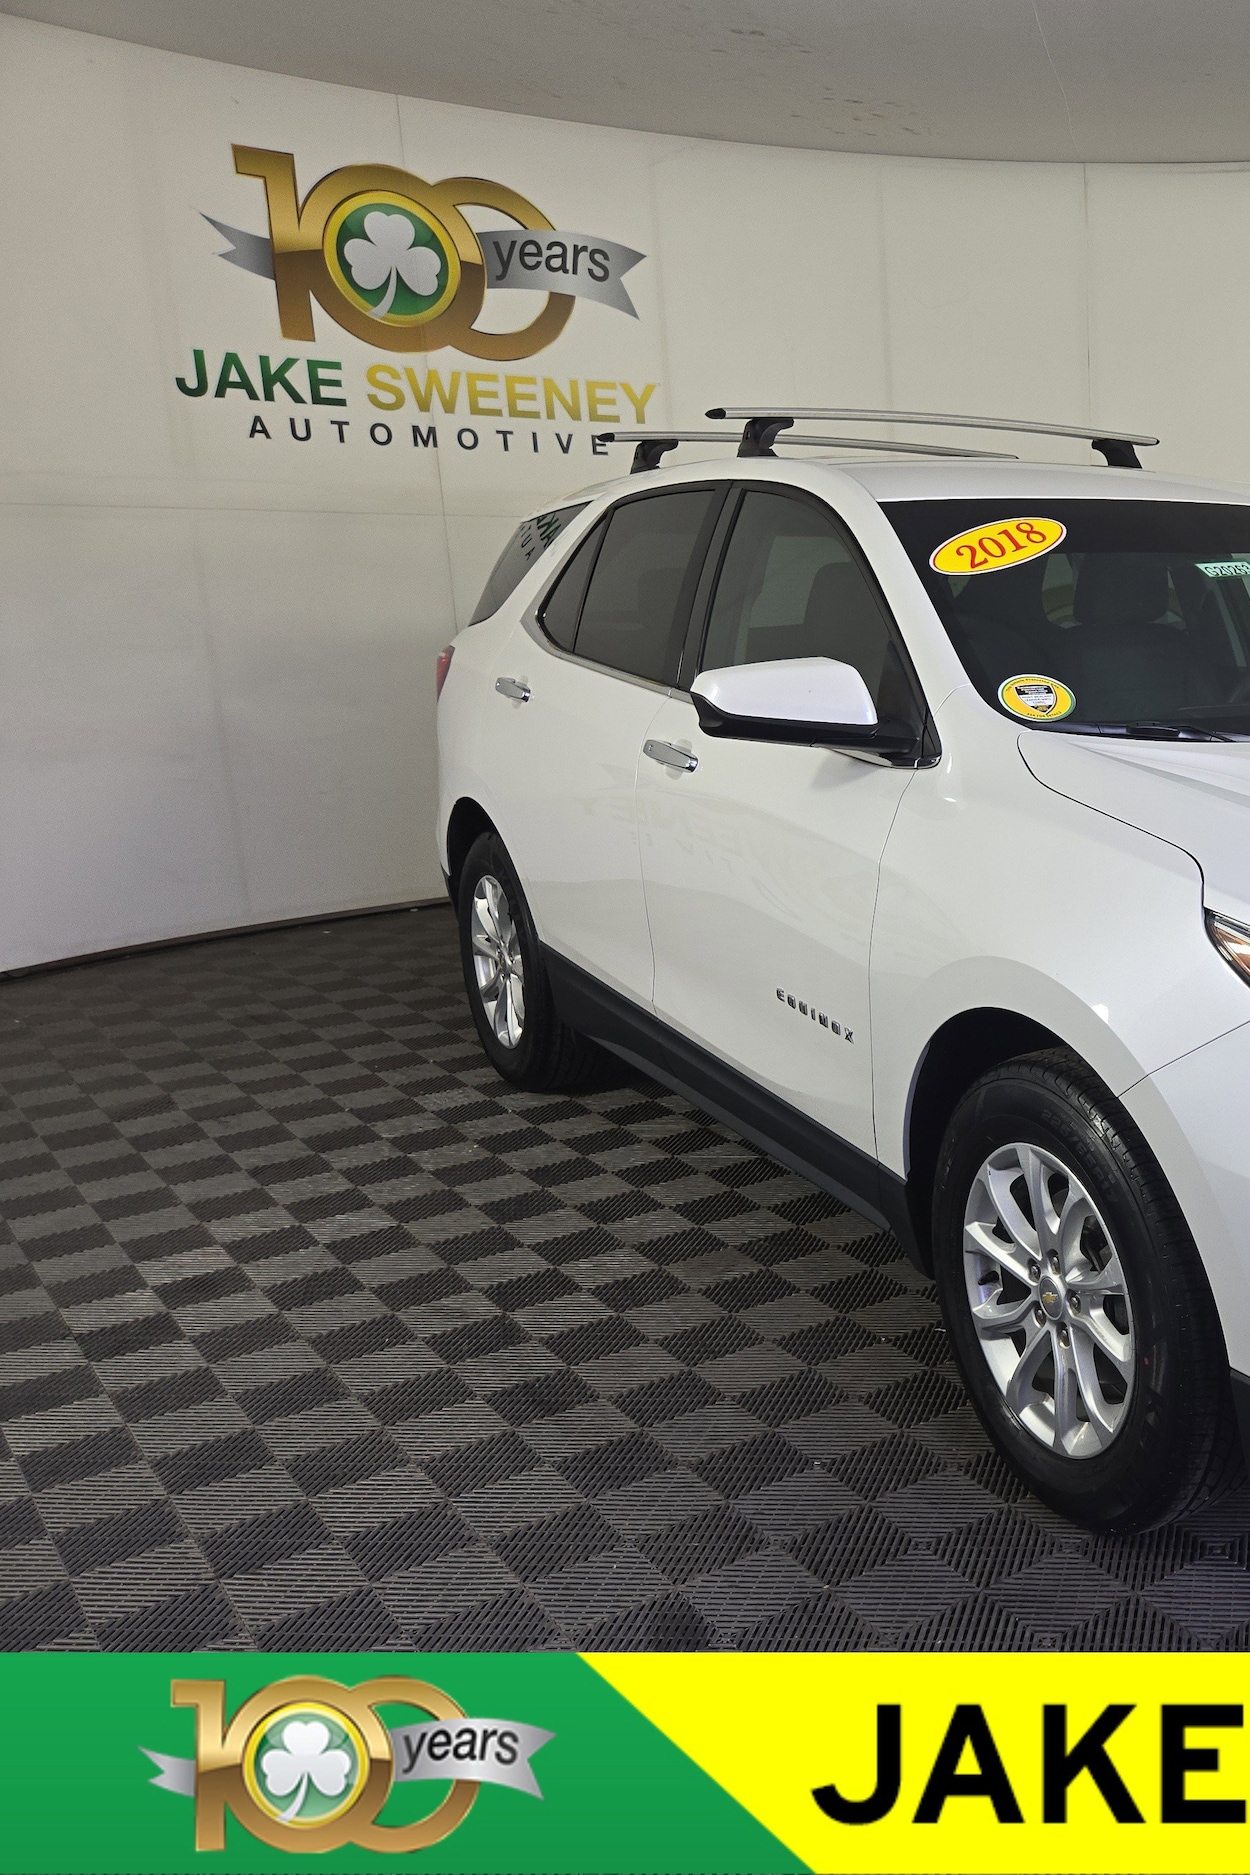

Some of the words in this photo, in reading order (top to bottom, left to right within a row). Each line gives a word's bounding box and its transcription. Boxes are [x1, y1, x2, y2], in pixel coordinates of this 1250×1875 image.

[231, 143, 577, 362] 100
[493, 234, 611, 283] years
[174, 349, 348, 408] JAKE
[365, 363, 658, 425] SWEENEY
[248, 414, 610, 457] AUTOMOTIVE
[955, 520, 1048, 571] 2018
[775, 987, 855, 1044] EQUINOX
